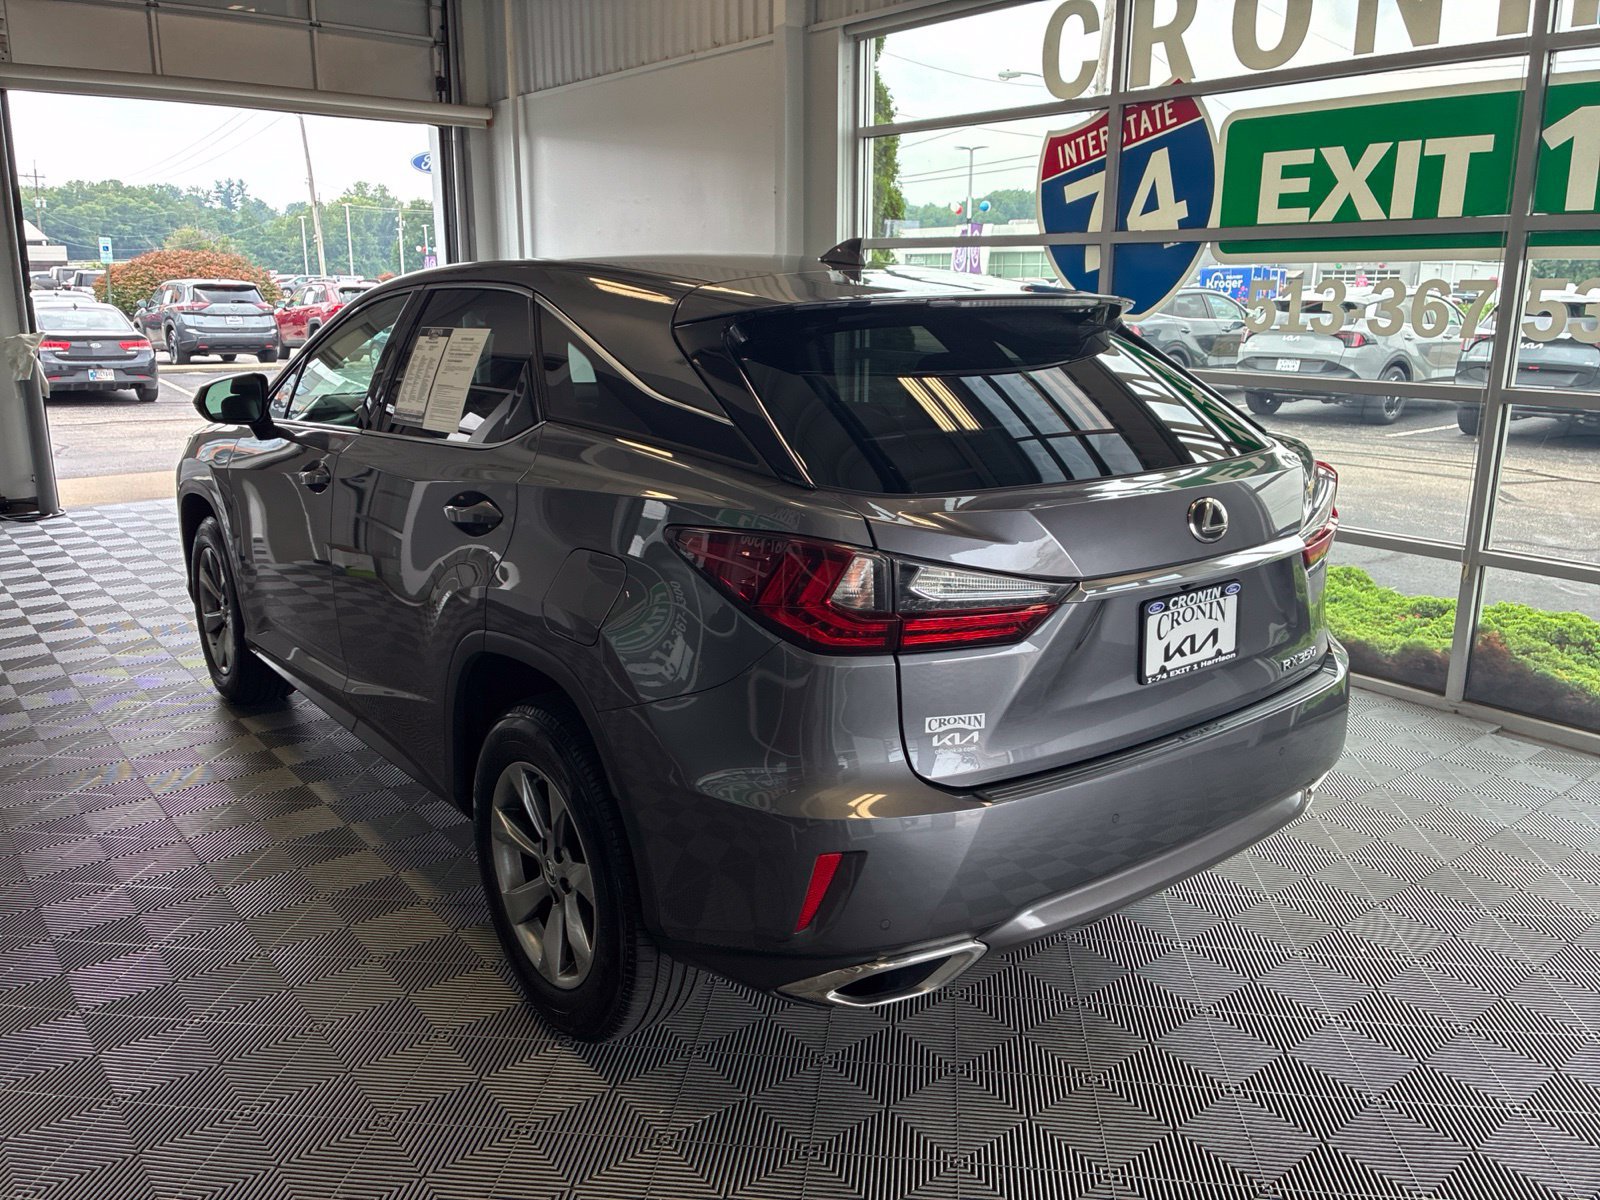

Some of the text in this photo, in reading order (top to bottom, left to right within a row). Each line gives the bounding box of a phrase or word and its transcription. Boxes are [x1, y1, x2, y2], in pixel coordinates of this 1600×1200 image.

[1043, 0, 1598, 99] CRON
[1057, 100, 1178, 169] INTERTATE
[1257, 134, 1495, 224] EXIT
[1064, 146, 1189, 273] 74
[1206, 272, 1243, 296] Kroger
[1157, 598, 1227, 640] CRONIN
[1169, 587, 1221, 610] CRONIN
[1147, 672, 1168, 684] I-74
[1170, 665, 1191, 677] EXIT
[1200, 653, 1236, 668] Harrison
[928, 714, 983, 731] CRONIN
